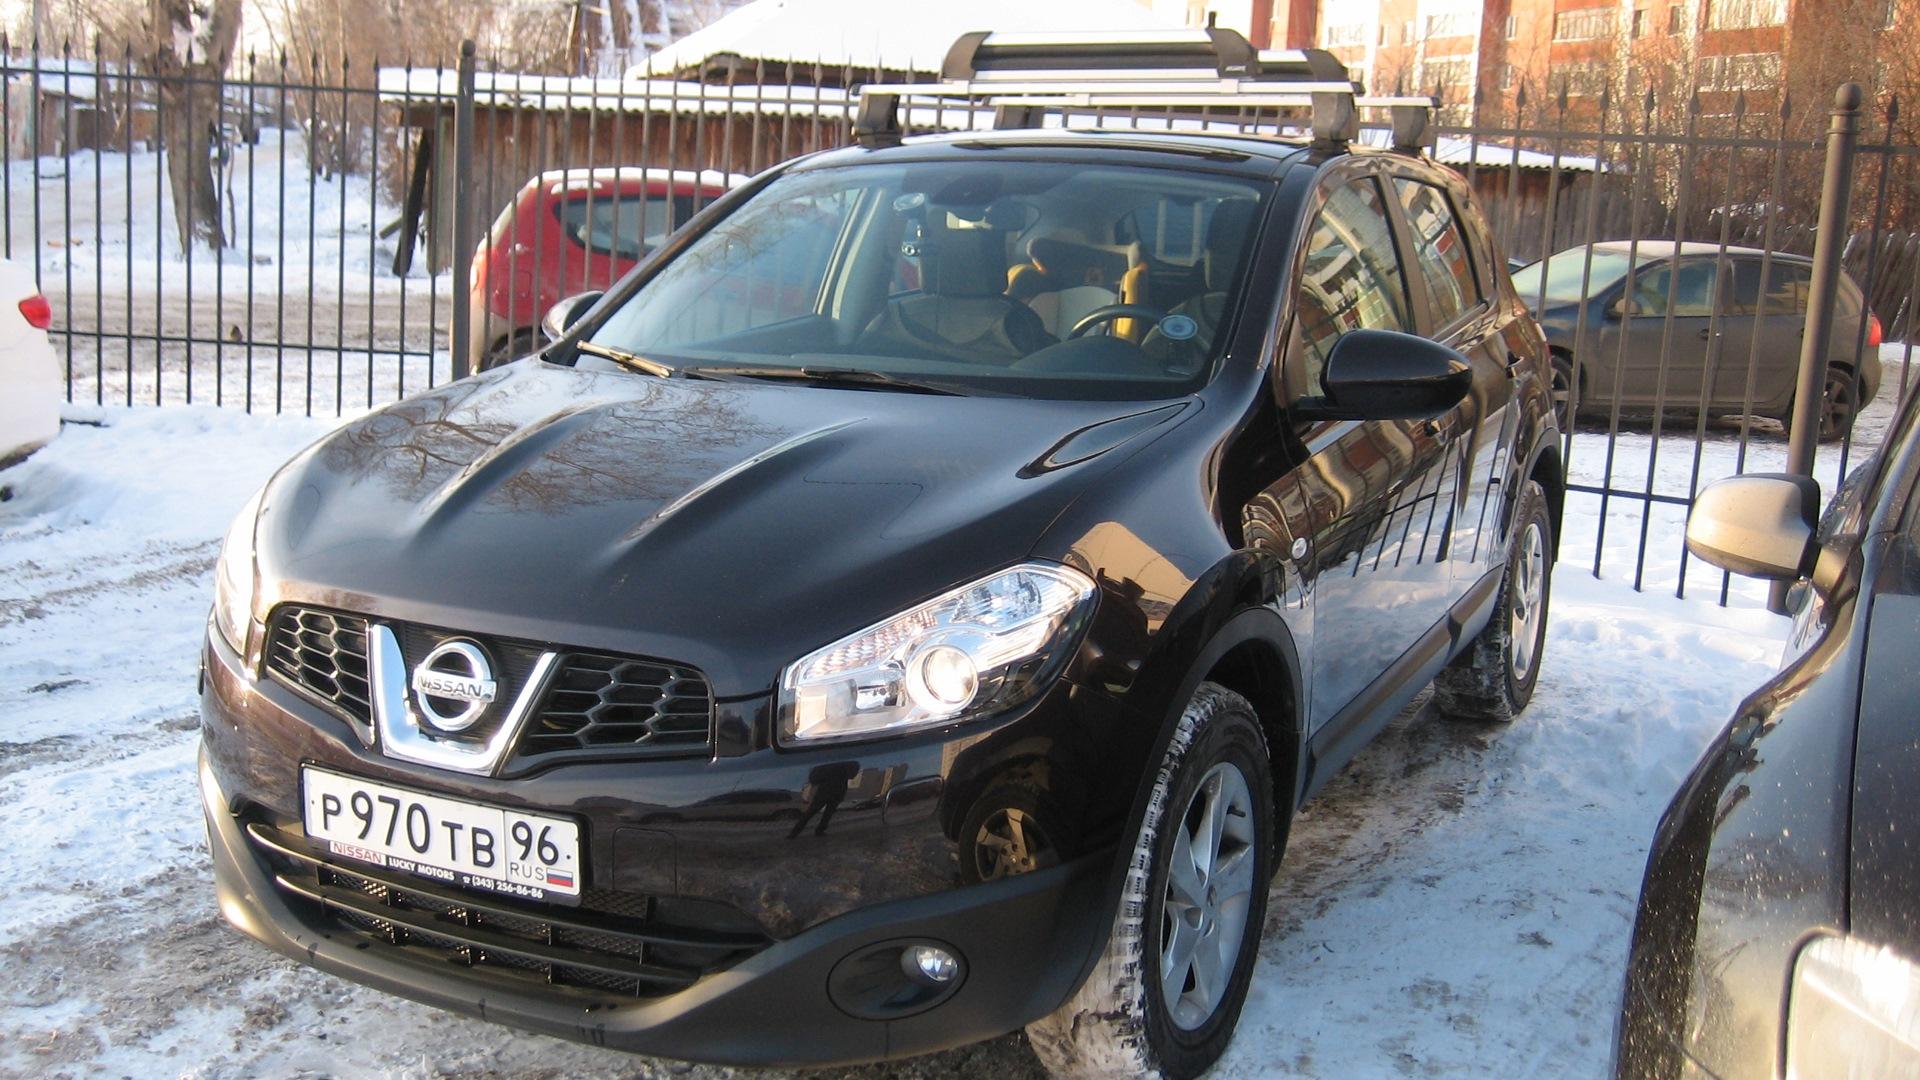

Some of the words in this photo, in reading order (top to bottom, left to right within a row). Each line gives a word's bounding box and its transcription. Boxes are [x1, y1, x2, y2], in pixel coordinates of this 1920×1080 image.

[417, 675, 482, 697] NISSAN
[511, 820, 559, 866] 96
[332, 842, 383, 864] NISSAN
[388, 856, 416, 872] LUCKY
[417, 862, 455, 880] MOTORS
[471, 875, 495, 890] (343)
[510, 862, 545, 881] RUS
